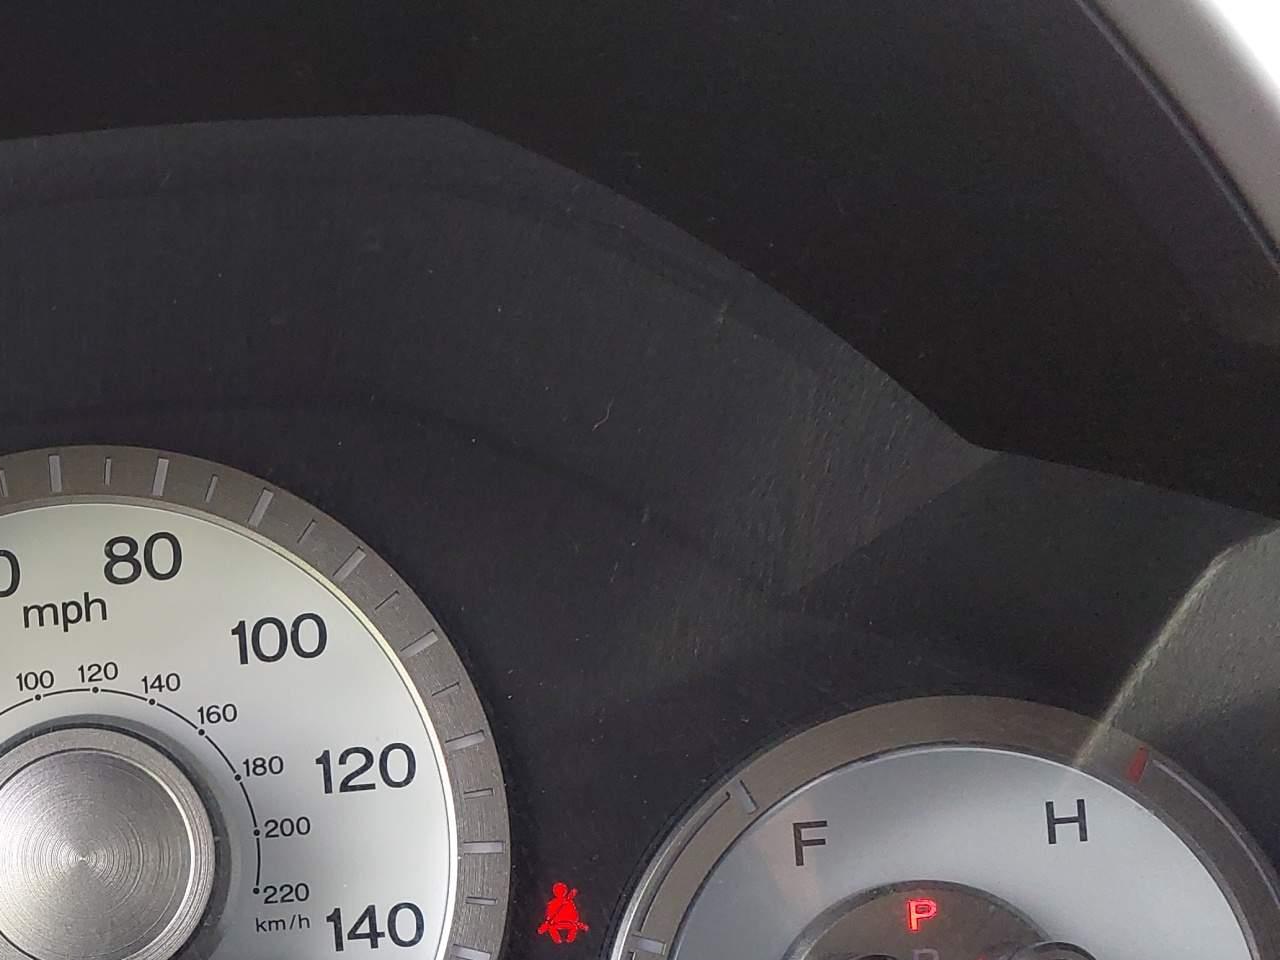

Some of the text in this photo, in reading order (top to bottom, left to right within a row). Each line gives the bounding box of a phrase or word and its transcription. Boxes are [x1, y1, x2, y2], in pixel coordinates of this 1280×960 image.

[103, 532, 183, 584] 80
[23, 593, 107, 632] mph
[231, 612, 327, 665] 100
[17, 670, 54, 691] 100
[78, 662, 118, 682] 120
[141, 673, 181, 693] 140
[198, 704, 237, 724] 160
[243, 756, 284, 776] 180
[315, 743, 416, 794] 120
[264, 816, 311, 838] 200
[1045, 799, 1088, 844] H
[793, 821, 828, 866] F
[263, 883, 310, 904] 220
[256, 914, 310, 933] km/h
[326, 902, 425, 952] 140
[906, 899, 937, 931] P
